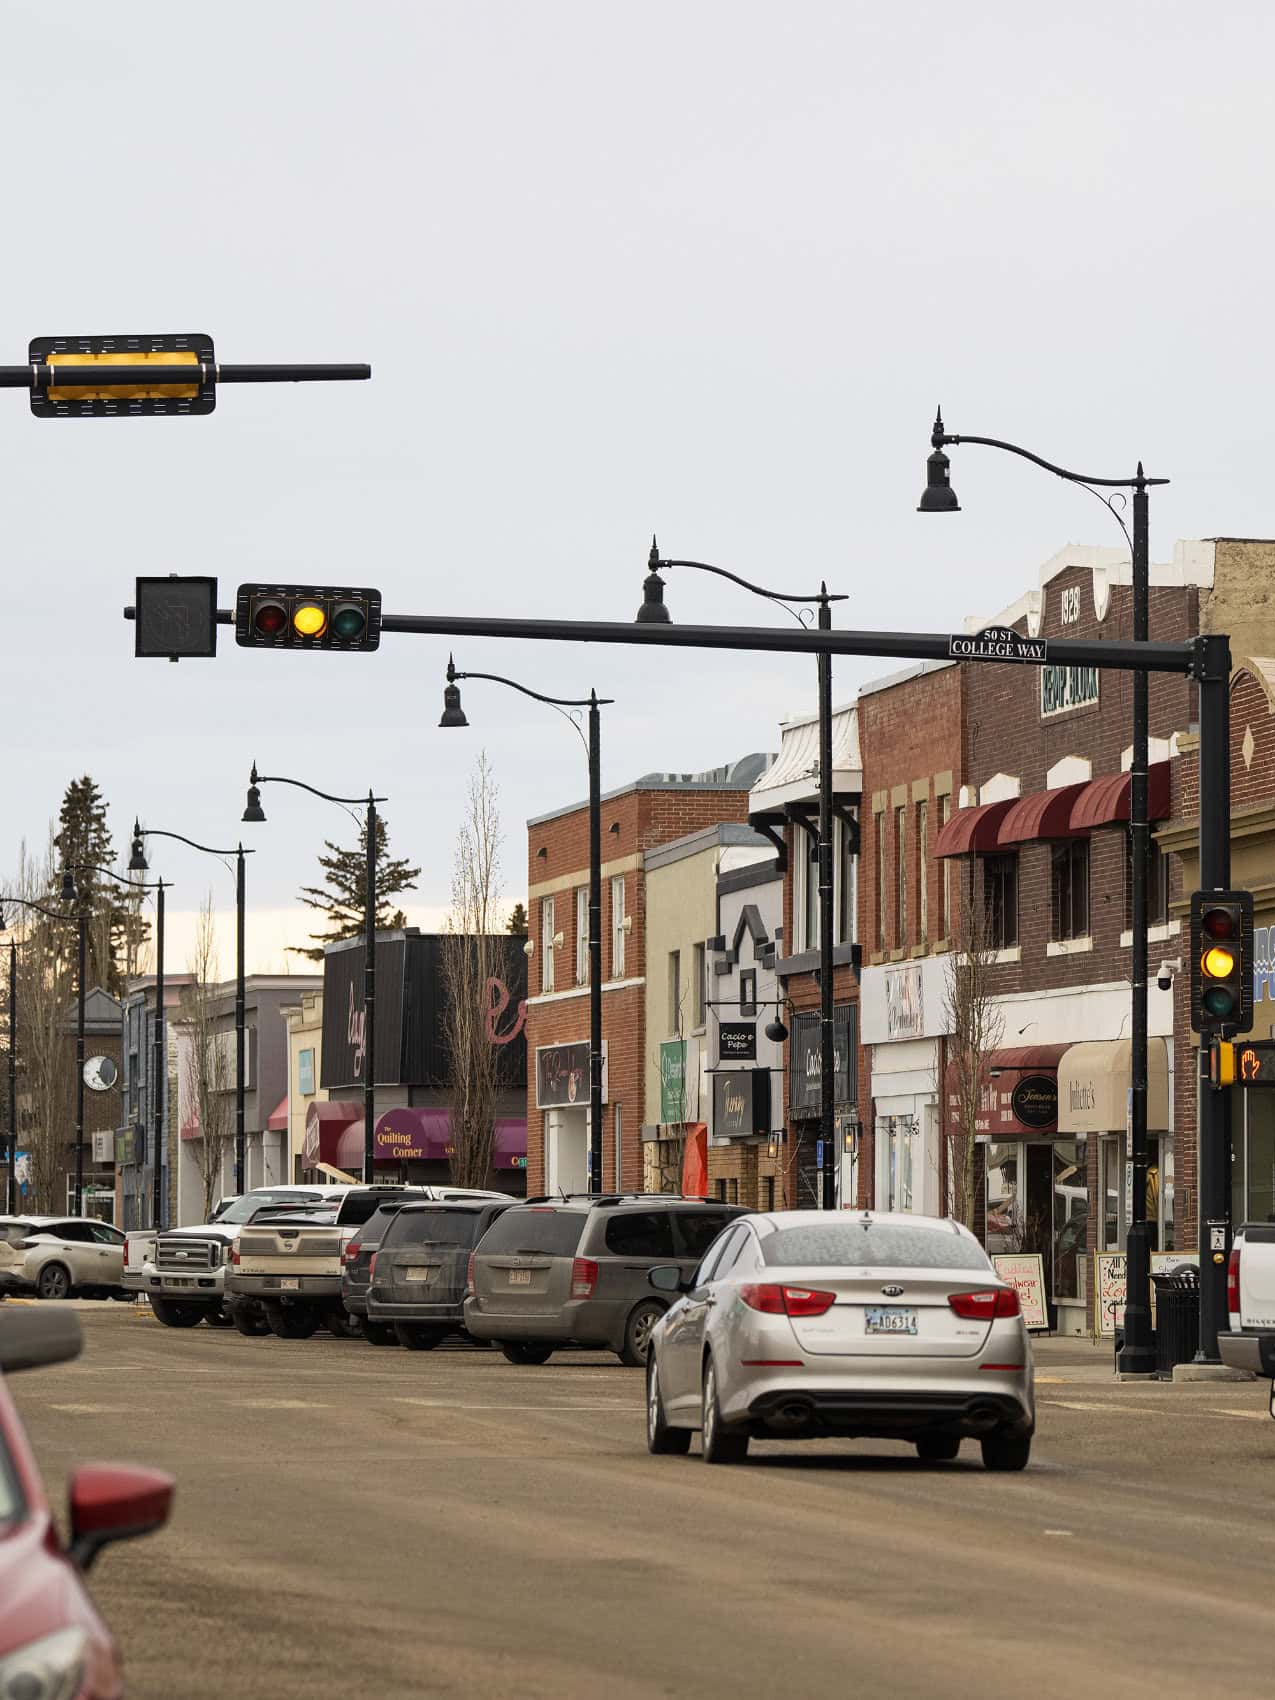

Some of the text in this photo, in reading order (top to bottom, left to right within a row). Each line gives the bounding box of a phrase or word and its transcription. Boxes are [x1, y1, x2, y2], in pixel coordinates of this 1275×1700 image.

[1061, 586, 1080, 625] 1928
[983, 630, 1013, 642] 50 ST
[952, 640, 1044, 658] COLLEGE WAY
[721, 1032, 754, 1041] Cacio e
[727, 1041, 748, 1050] Pepe
[377, 1132, 411, 1146] Quilting
[392, 1147, 422, 1158] Corner
